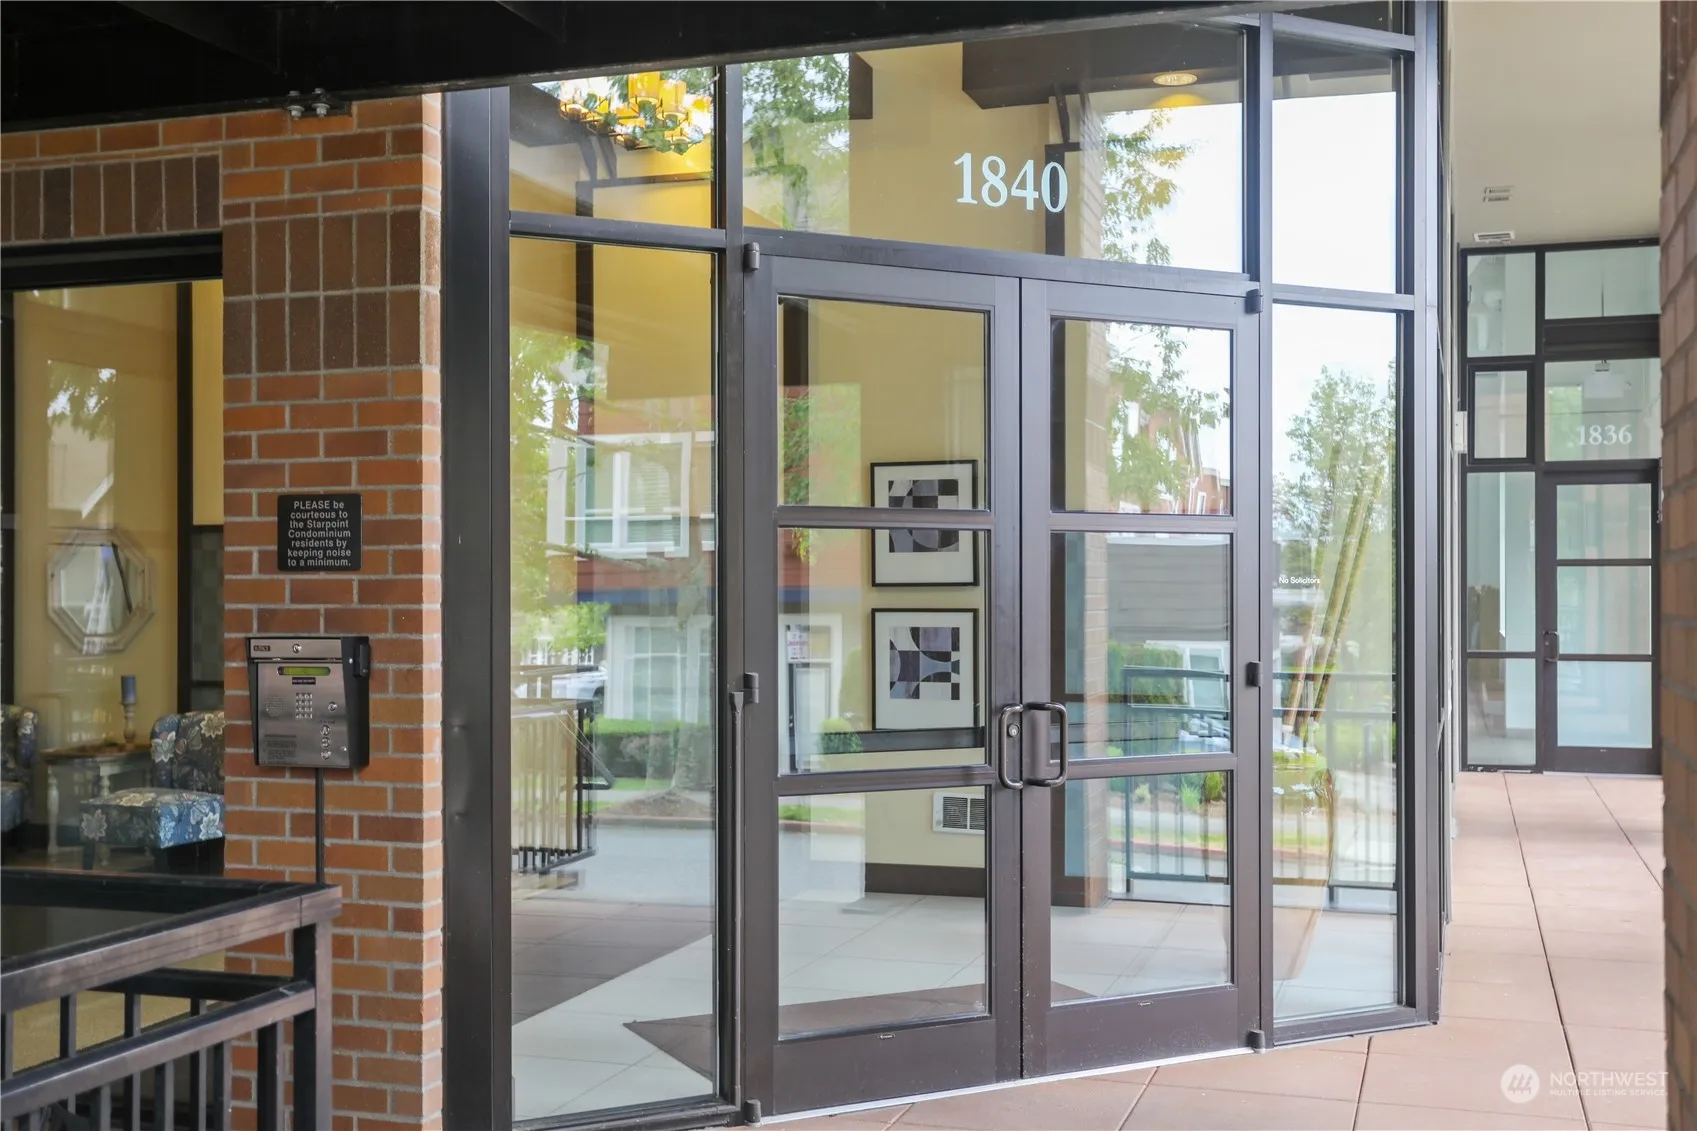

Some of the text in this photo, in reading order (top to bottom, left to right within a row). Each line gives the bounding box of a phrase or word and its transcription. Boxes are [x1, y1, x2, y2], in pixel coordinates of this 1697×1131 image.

[954, 152, 1068, 213] 1840
[1577, 424, 1632, 446] 1836
[293, 500, 345, 510] PLEASE be
[290, 510, 348, 519] courteous to
[289, 519, 349, 531] the Starpoint
[288, 529, 351, 538] Condominium
[291, 538, 347, 549] residents by
[287, 548, 352, 559] keeping noise
[287, 558, 351, 567] to a minimum.
[1278, 576, 1320, 584] No Solicitors
